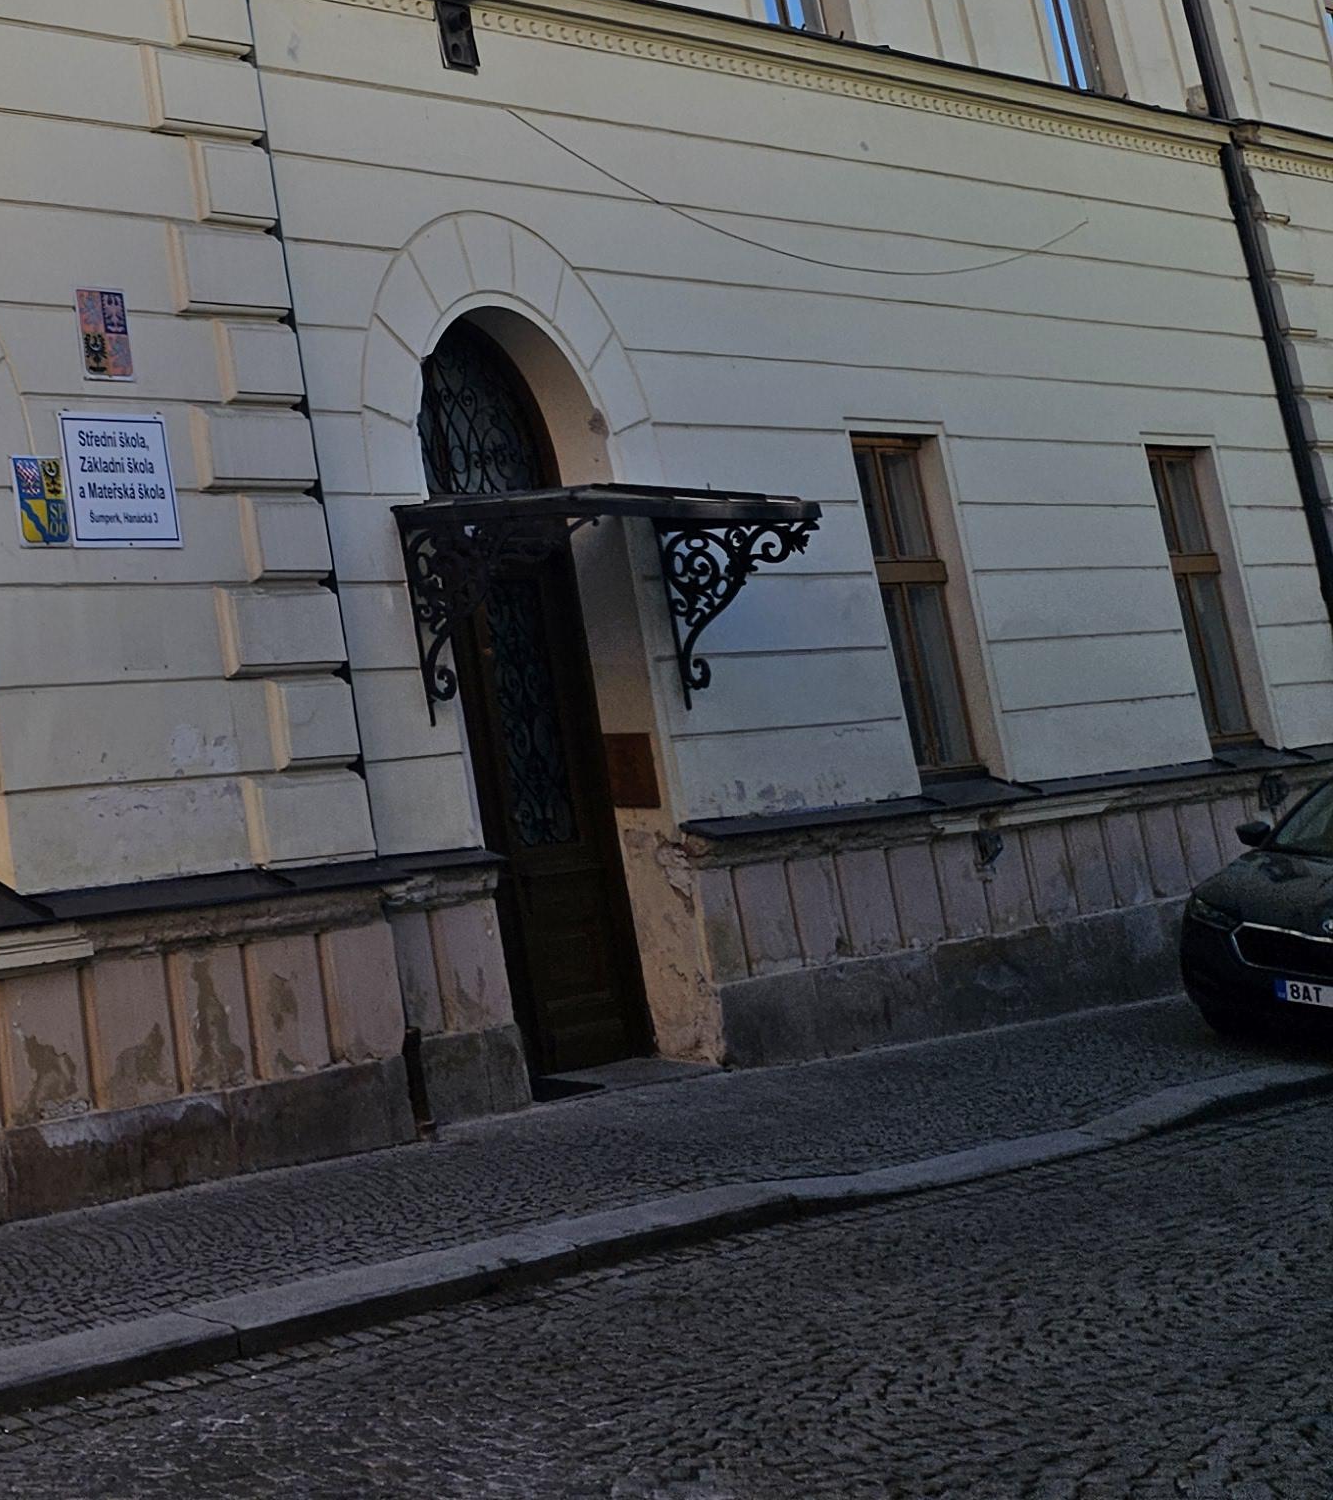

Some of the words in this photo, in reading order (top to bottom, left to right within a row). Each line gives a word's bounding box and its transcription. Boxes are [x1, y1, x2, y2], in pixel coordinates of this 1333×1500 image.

[78, 430, 118, 448] Střední
[119, 431, 150, 451] škola,
[79, 456, 125, 473] Základní
[127, 457, 155, 474] škola
[79, 486, 86, 499] a
[87, 482, 136, 500] Mateřská
[138, 483, 166, 500] škola
[153, 512, 159, 524] 3
[1289, 984, 1322, 1003] 8AT
